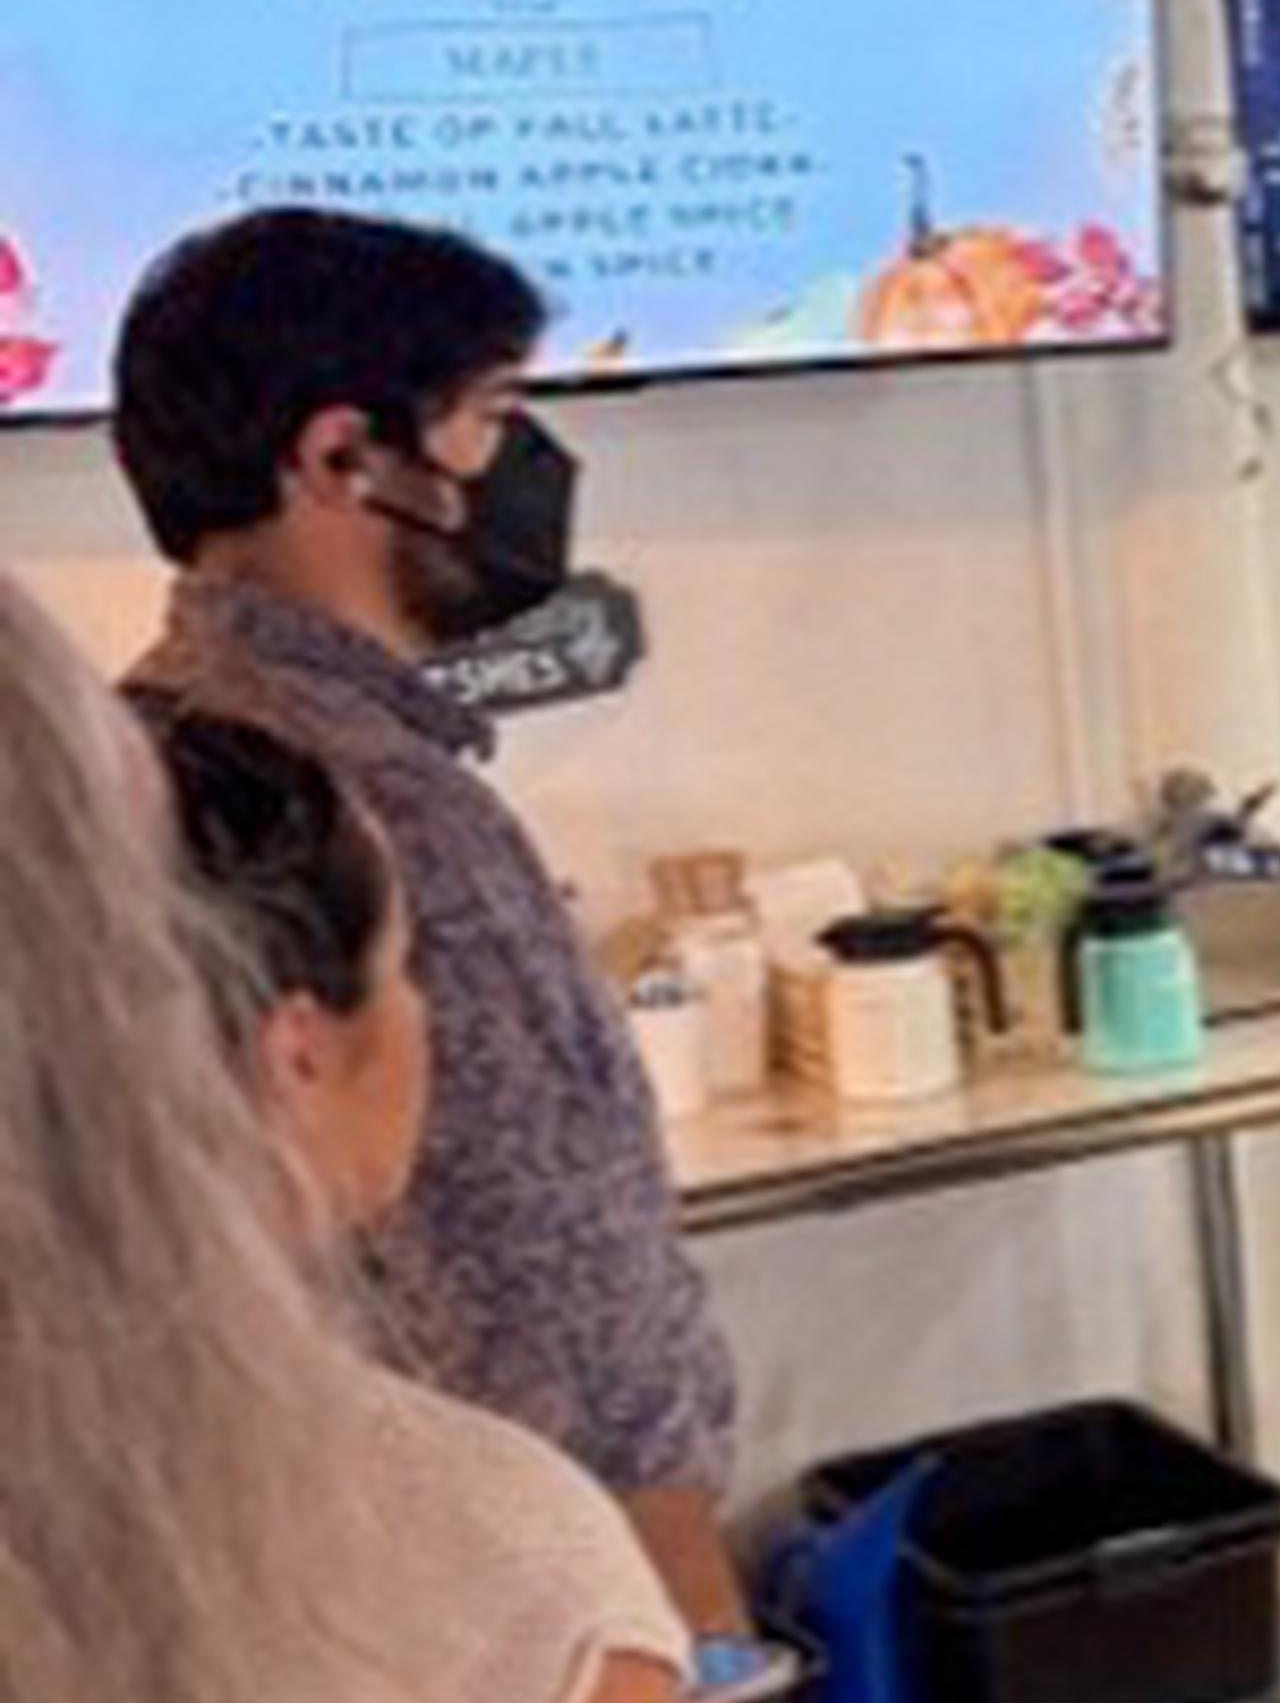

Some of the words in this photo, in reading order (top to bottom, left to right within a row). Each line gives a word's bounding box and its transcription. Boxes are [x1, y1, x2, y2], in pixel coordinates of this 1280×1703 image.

[515, 113, 627, 141] FALL
[518, 159, 655, 190] APPLE
[512, 204, 650, 237] APPLE
[668, 196, 797, 228] SPICE
[591, 249, 716, 279] SPICE
